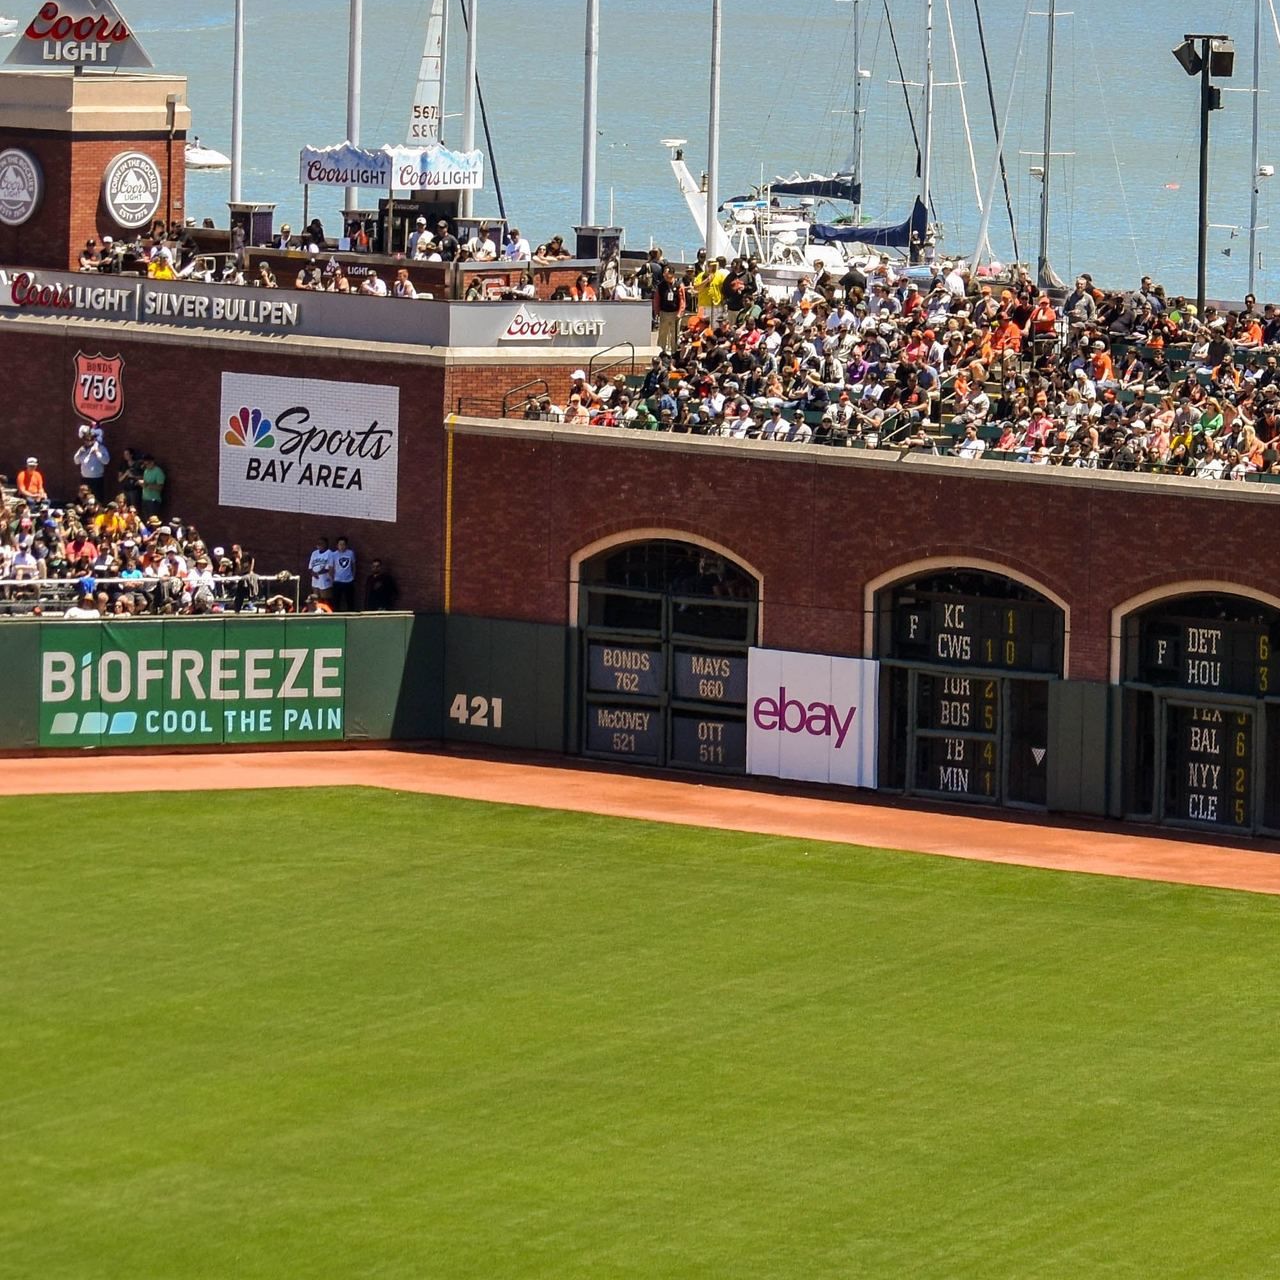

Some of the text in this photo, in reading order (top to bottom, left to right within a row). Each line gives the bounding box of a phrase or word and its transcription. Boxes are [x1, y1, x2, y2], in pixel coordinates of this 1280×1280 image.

[25, 1, 130, 41] Coors
[43, 40, 112, 62] LIGHT
[111, 167, 123, 194] BORN
[127, 159, 141, 169] THE
[140, 160, 158, 194] ROCKIES
[119, 179, 149, 195] Coors
[307, 160, 386, 186] Coors LIGHT
[399, 164, 479, 187] Coors LIGHT
[124, 193, 142, 201] LIGHT
[347, 266, 369, 276] LIGHT
[11, 272, 299, 327] Coors LIGHT SILVER BULLPEN
[507, 314, 607, 337] Coors LIGHT
[86, 361, 113, 374] BONDS
[80, 374, 117, 402] 756
[275, 406, 394, 465] Sports
[246, 458, 363, 491] BAY AREA
[909, 614, 919, 640] F
[943, 603, 1015, 635] KC 1
[937, 632, 972, 661] CWS
[1157, 640, 1167, 665] F
[1187, 627, 1270, 660] DET 6
[603, 648, 731, 678] BONDS MAYS
[1187, 659, 1269, 692] HOU 3
[614, 672, 724, 699] 762 660
[943, 677, 971, 696] TOR
[146, 707, 342, 734] COOL THE PAIN
[449, 693, 503, 728] 421
[753, 686, 857, 749] ebay
[940, 700, 994, 729] BOS 5
[598, 709, 724, 742] McCOVEY OTT
[612, 732, 724, 764] 521 511
[945, 738, 993, 766] TB 4
[1190, 726, 1245, 757] BAL 6
[938, 766, 992, 796] MIN 1
[1188, 762, 1245, 793] NYY 2
[1188, 794, 1244, 825] CLE 5
